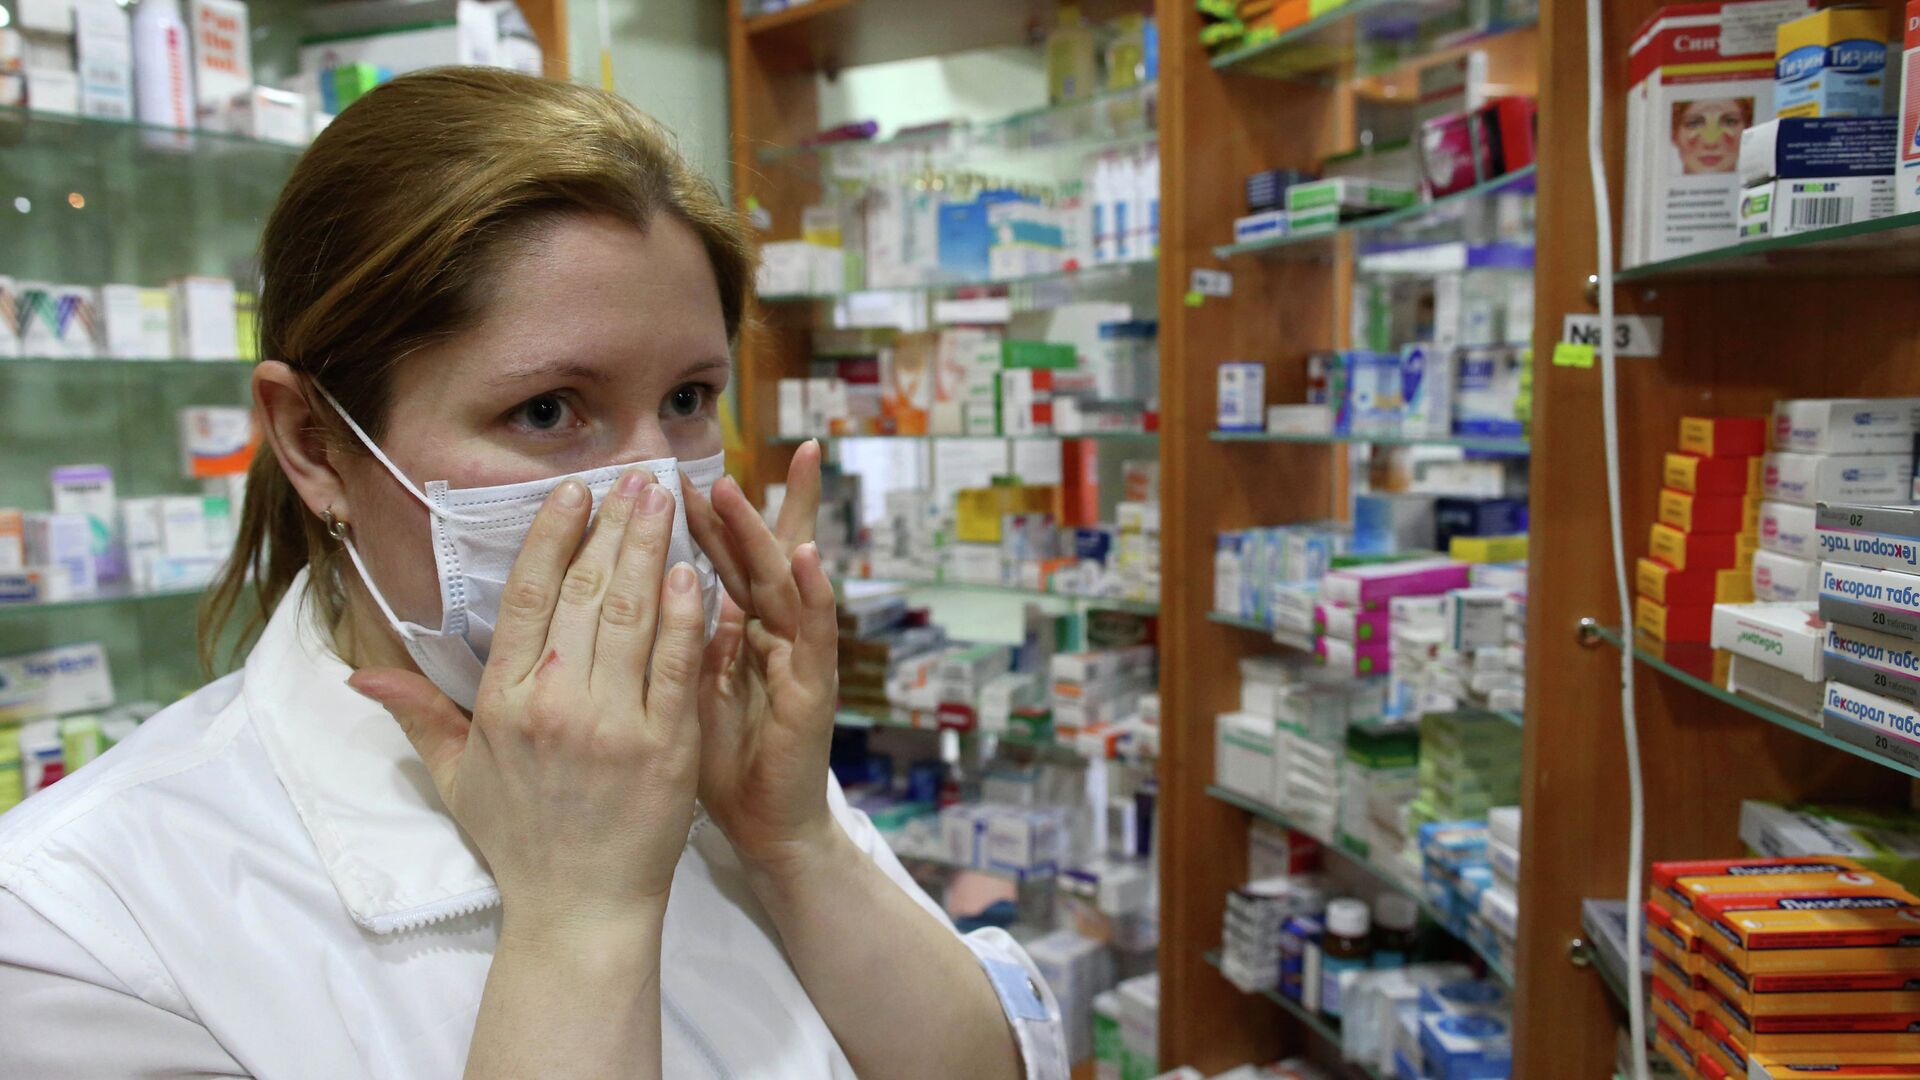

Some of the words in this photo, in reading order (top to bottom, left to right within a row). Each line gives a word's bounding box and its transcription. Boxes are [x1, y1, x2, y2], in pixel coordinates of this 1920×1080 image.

[1779, 51, 1825, 81] Тизин
[1830, 45, 1884, 70] Тизин
[1849, 514, 1863, 527] 20
[1821, 534, 1850, 552] табс
[1854, 537, 1917, 565] Гексорал
[1824, 571, 1882, 599] Гексорал
[1886, 586, 1920, 606] табс
[1872, 611, 1885, 625] 20
[1828, 630, 1884, 661] Гексорал
[1887, 650, 1919, 671] табс
[1874, 673, 1887, 687] 20
[1828, 688, 1885, 724] Гексорал
[1888, 714, 1920, 737] табс
[1875, 735, 1888, 749] 20
